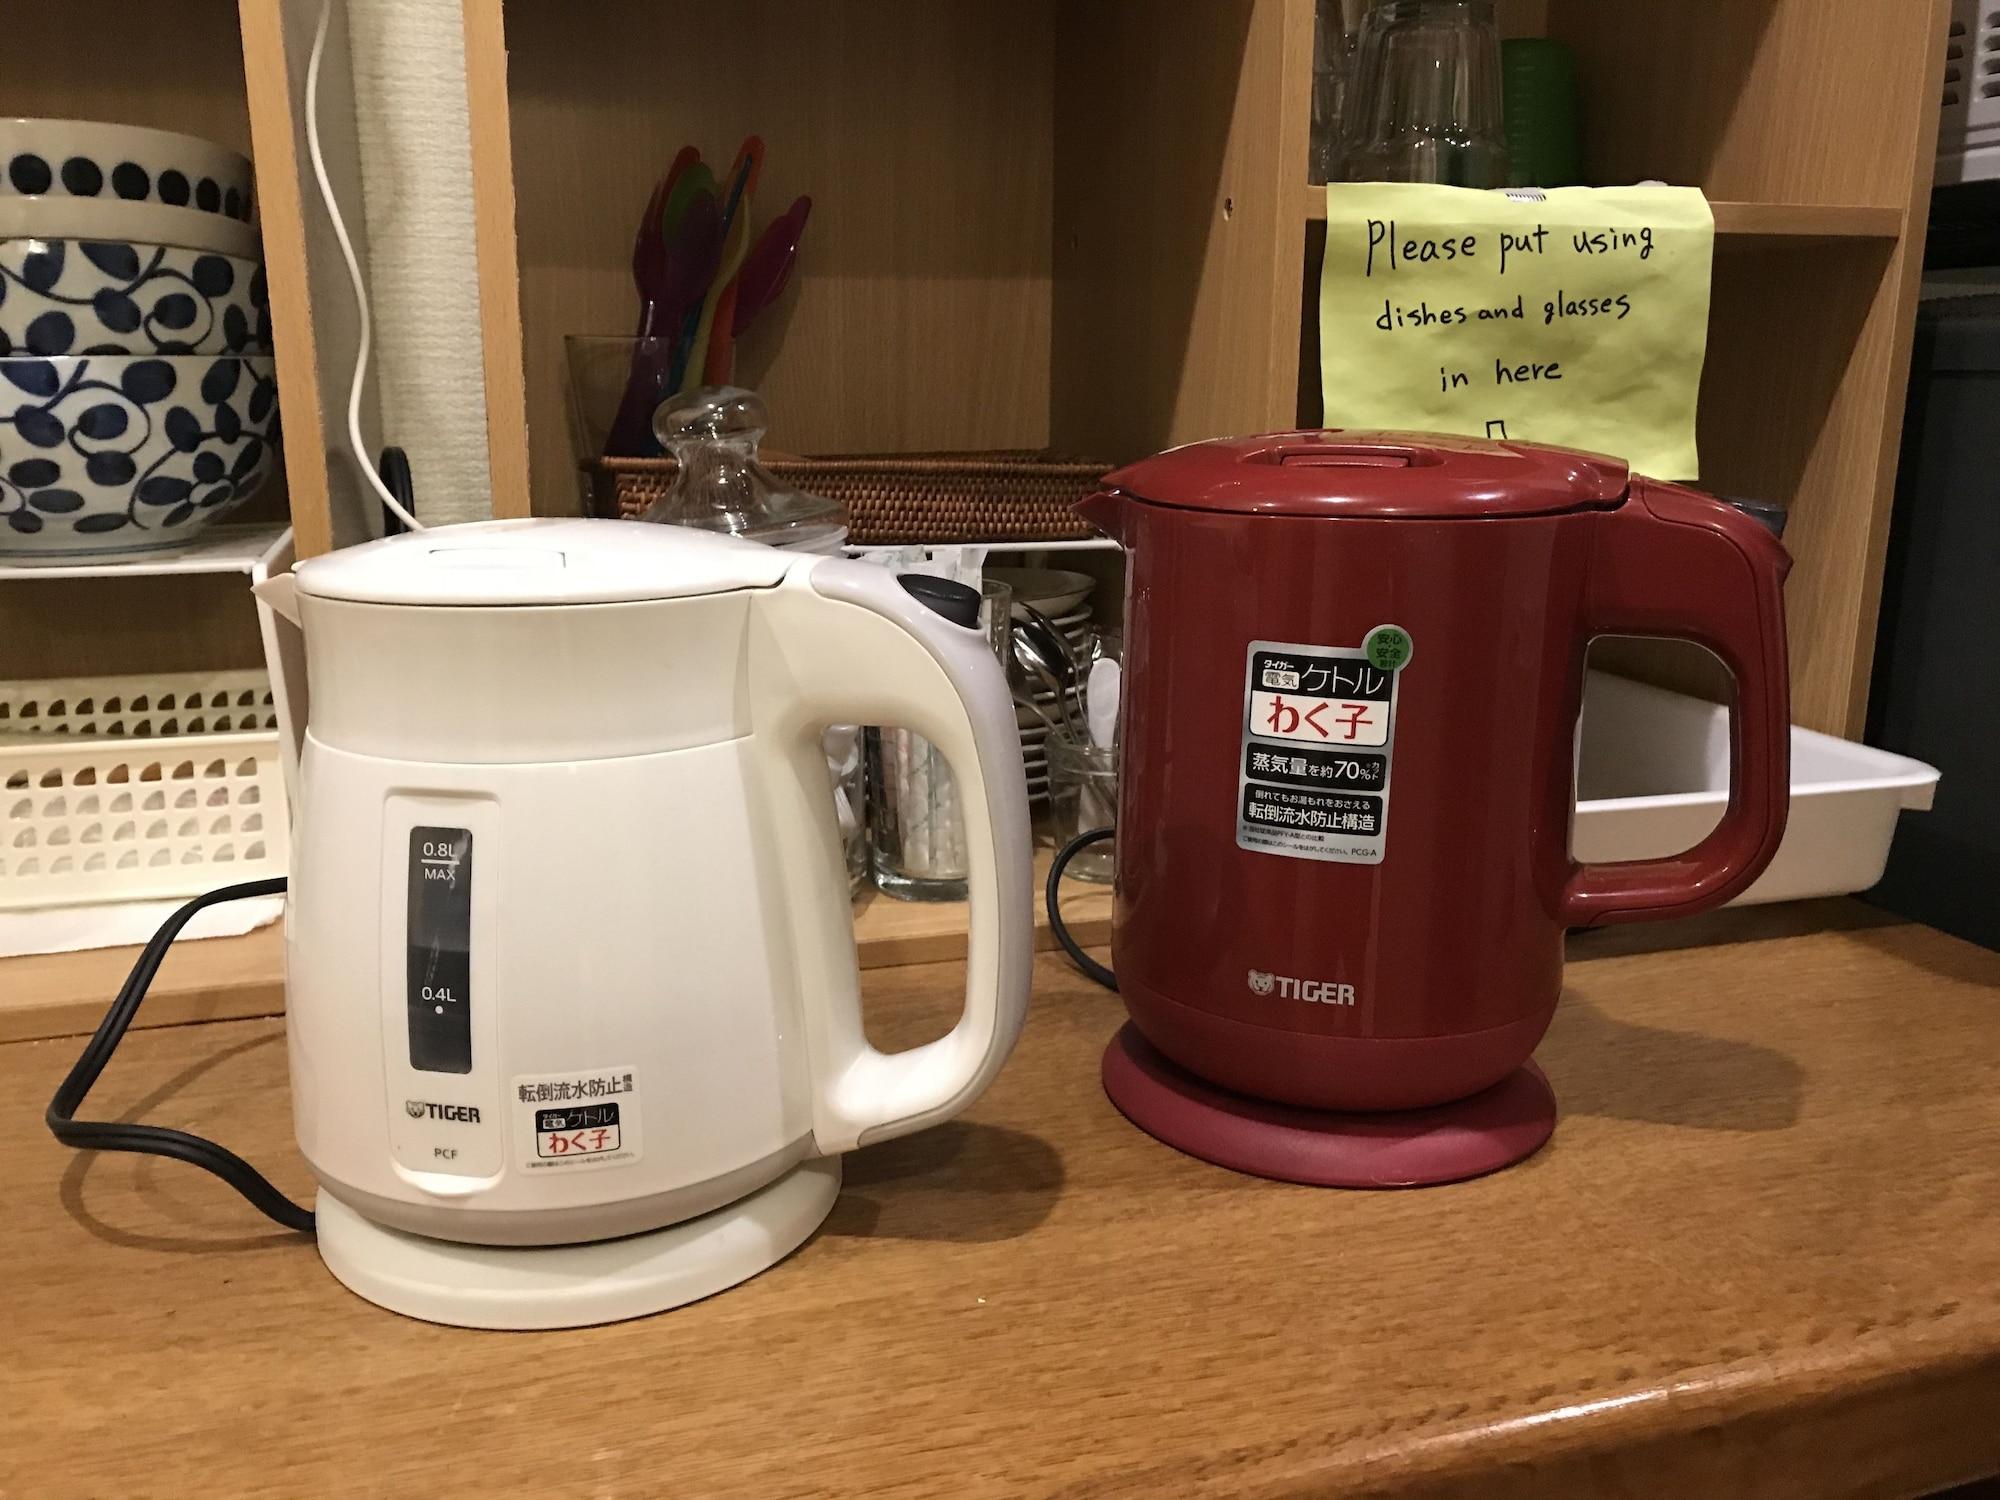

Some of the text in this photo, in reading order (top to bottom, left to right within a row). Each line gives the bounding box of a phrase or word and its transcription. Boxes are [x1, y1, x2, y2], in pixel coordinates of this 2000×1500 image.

[1366, 219, 1654, 276] Please put using
[1376, 290, 1631, 330] dishes and glasses
[1441, 358, 1562, 392] in here
[1263, 659, 1295, 670] タイガー
[1265, 671, 1298, 688] 電気
[1301, 663, 1385, 694] ケトル
[1267, 695, 1373, 739] わく子
[1248, 802, 1375, 831] 転倒流水防止構造
[423, 842, 457, 858] 0.8L
[1351, 848, 1377, 857] PCG-A
[424, 868, 456, 881] MAX
[421, 986, 457, 1002] 0.4L
[1275, 975, 1355, 1006] TIGER
[425, 1102, 481, 1124] TIGER
[434, 1147, 458, 1160] PCF
[548, 1128, 611, 1154] わく子
